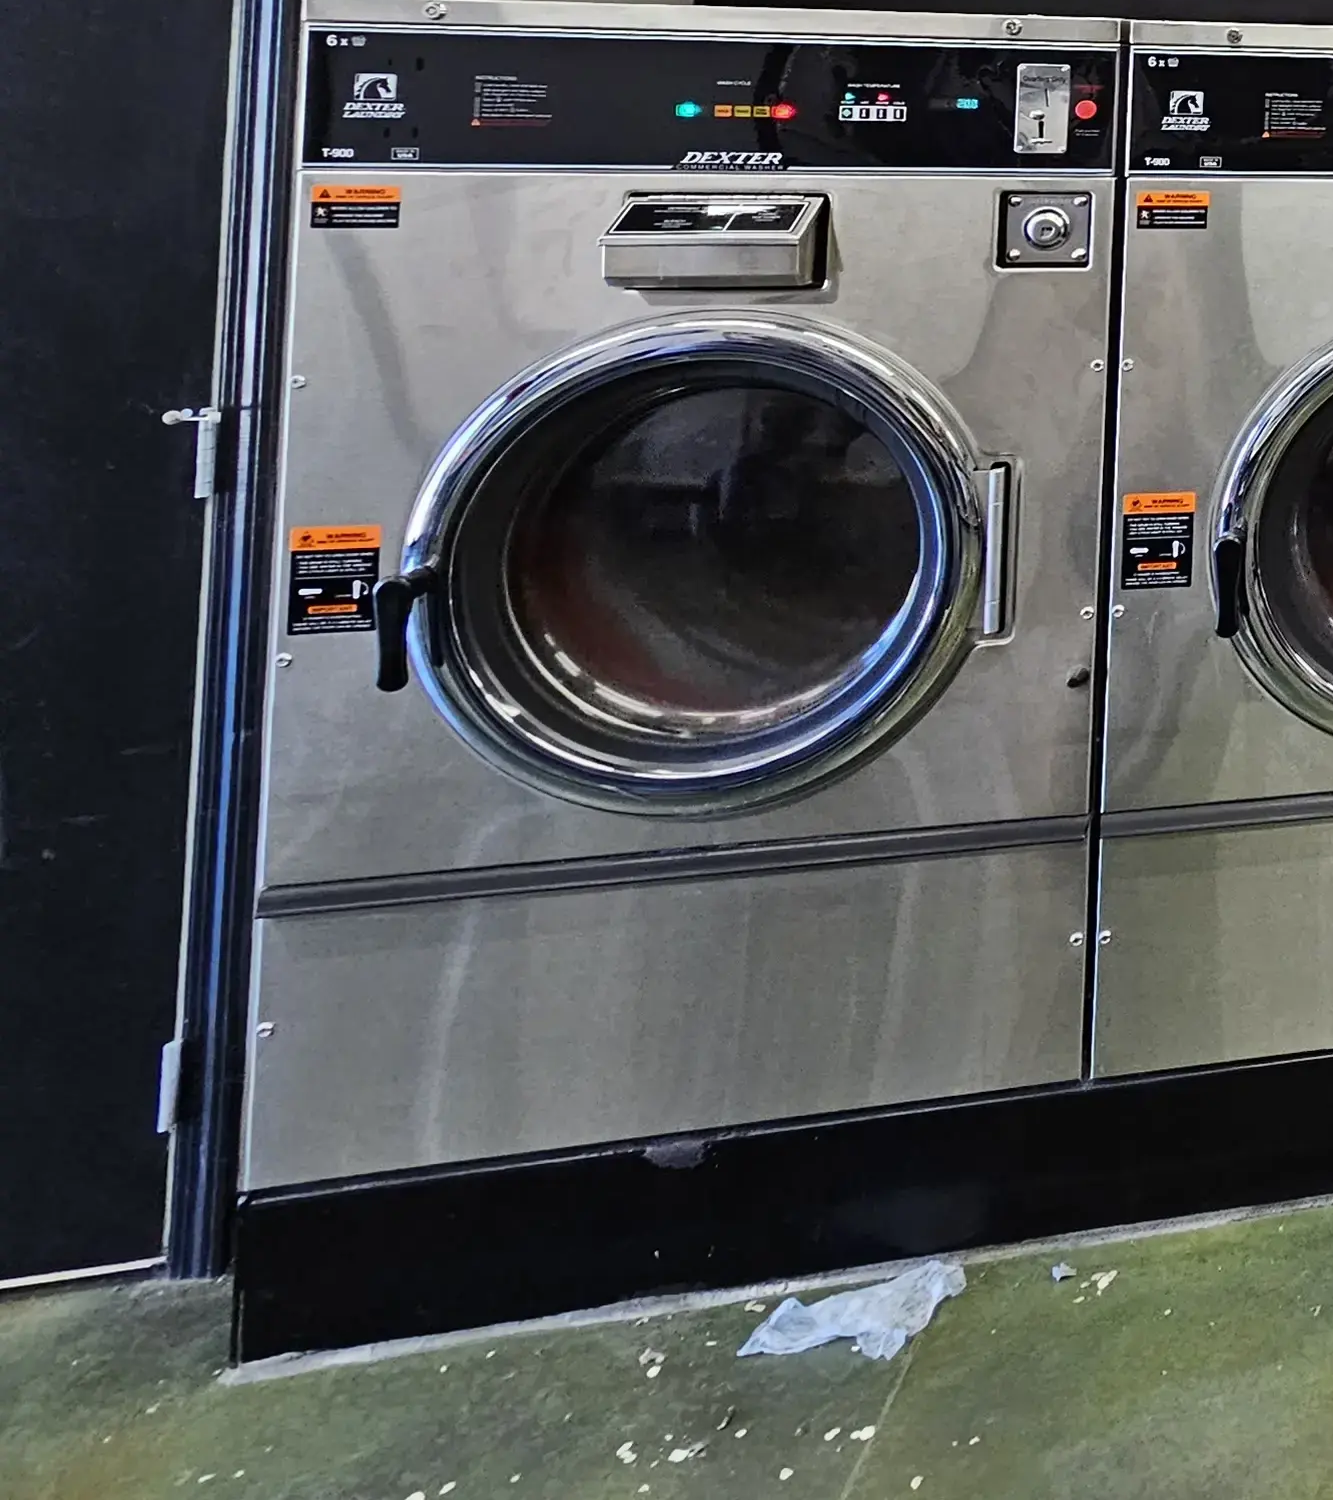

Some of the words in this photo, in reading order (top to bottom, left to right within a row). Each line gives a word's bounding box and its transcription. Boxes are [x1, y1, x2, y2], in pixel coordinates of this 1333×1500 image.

[326, 34, 338, 47] 6
[1147, 56, 1157, 67] 6
[343, 102, 406, 111] DEXTER
[1161, 116, 1211, 125] DEXTER
[680, 151, 783, 165] DEXTER
